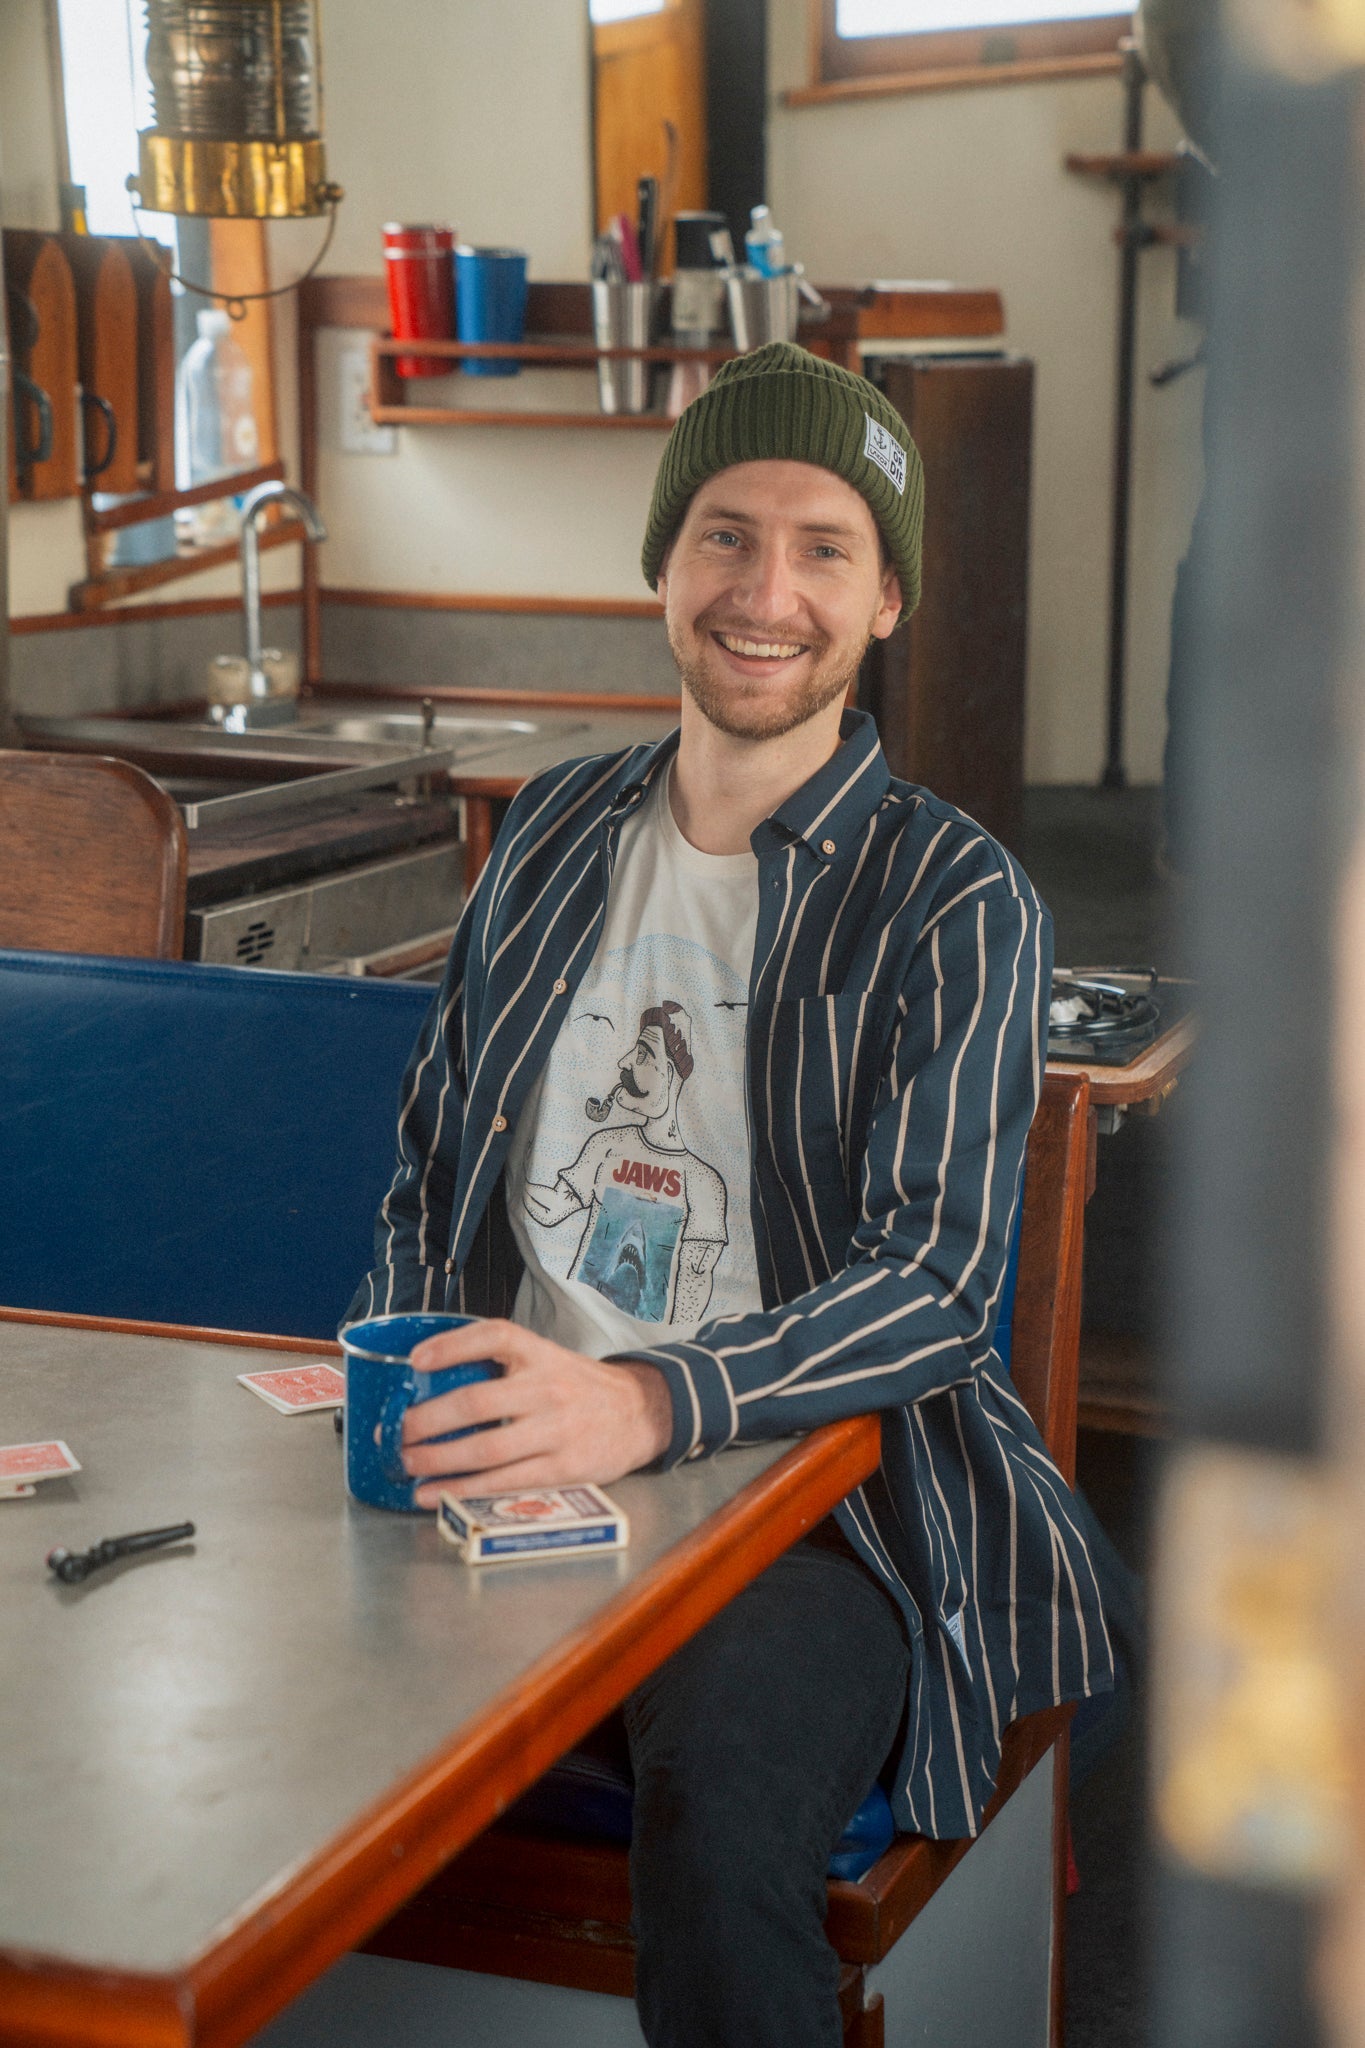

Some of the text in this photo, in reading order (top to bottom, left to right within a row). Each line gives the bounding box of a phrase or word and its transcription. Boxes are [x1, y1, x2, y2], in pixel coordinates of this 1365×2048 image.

[891, 439, 904, 458] FISH
[894, 451, 903, 469] OR
[890, 462, 903, 484] DIE
[612, 1159, 681, 1197] JAWS
